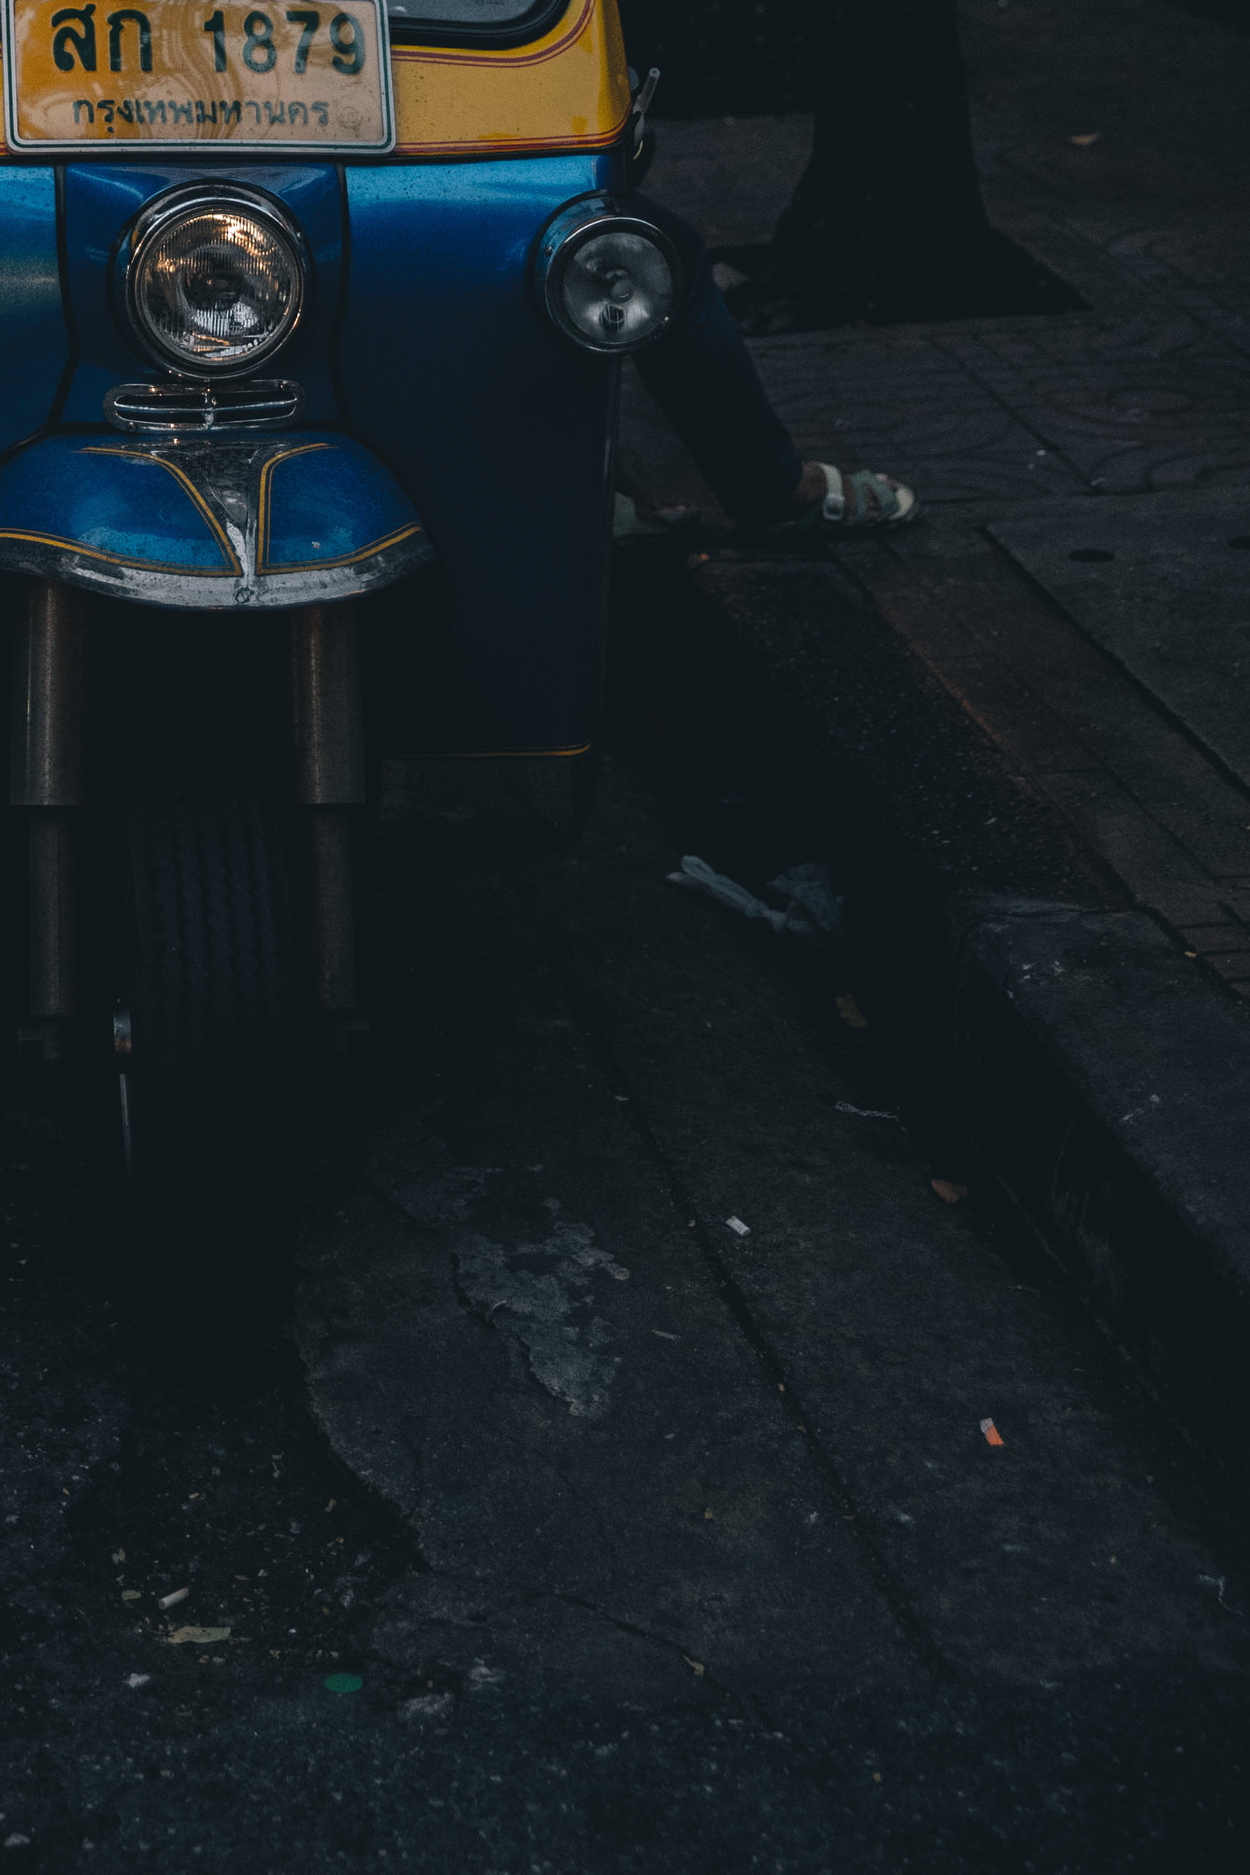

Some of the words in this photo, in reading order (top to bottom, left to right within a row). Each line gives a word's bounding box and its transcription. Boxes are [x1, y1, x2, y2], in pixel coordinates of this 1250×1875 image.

[51, 3, 151, 73] สก
[204, 10, 365, 75] 1879
[72, 98, 330, 134] กรุงเทพมหานคร
